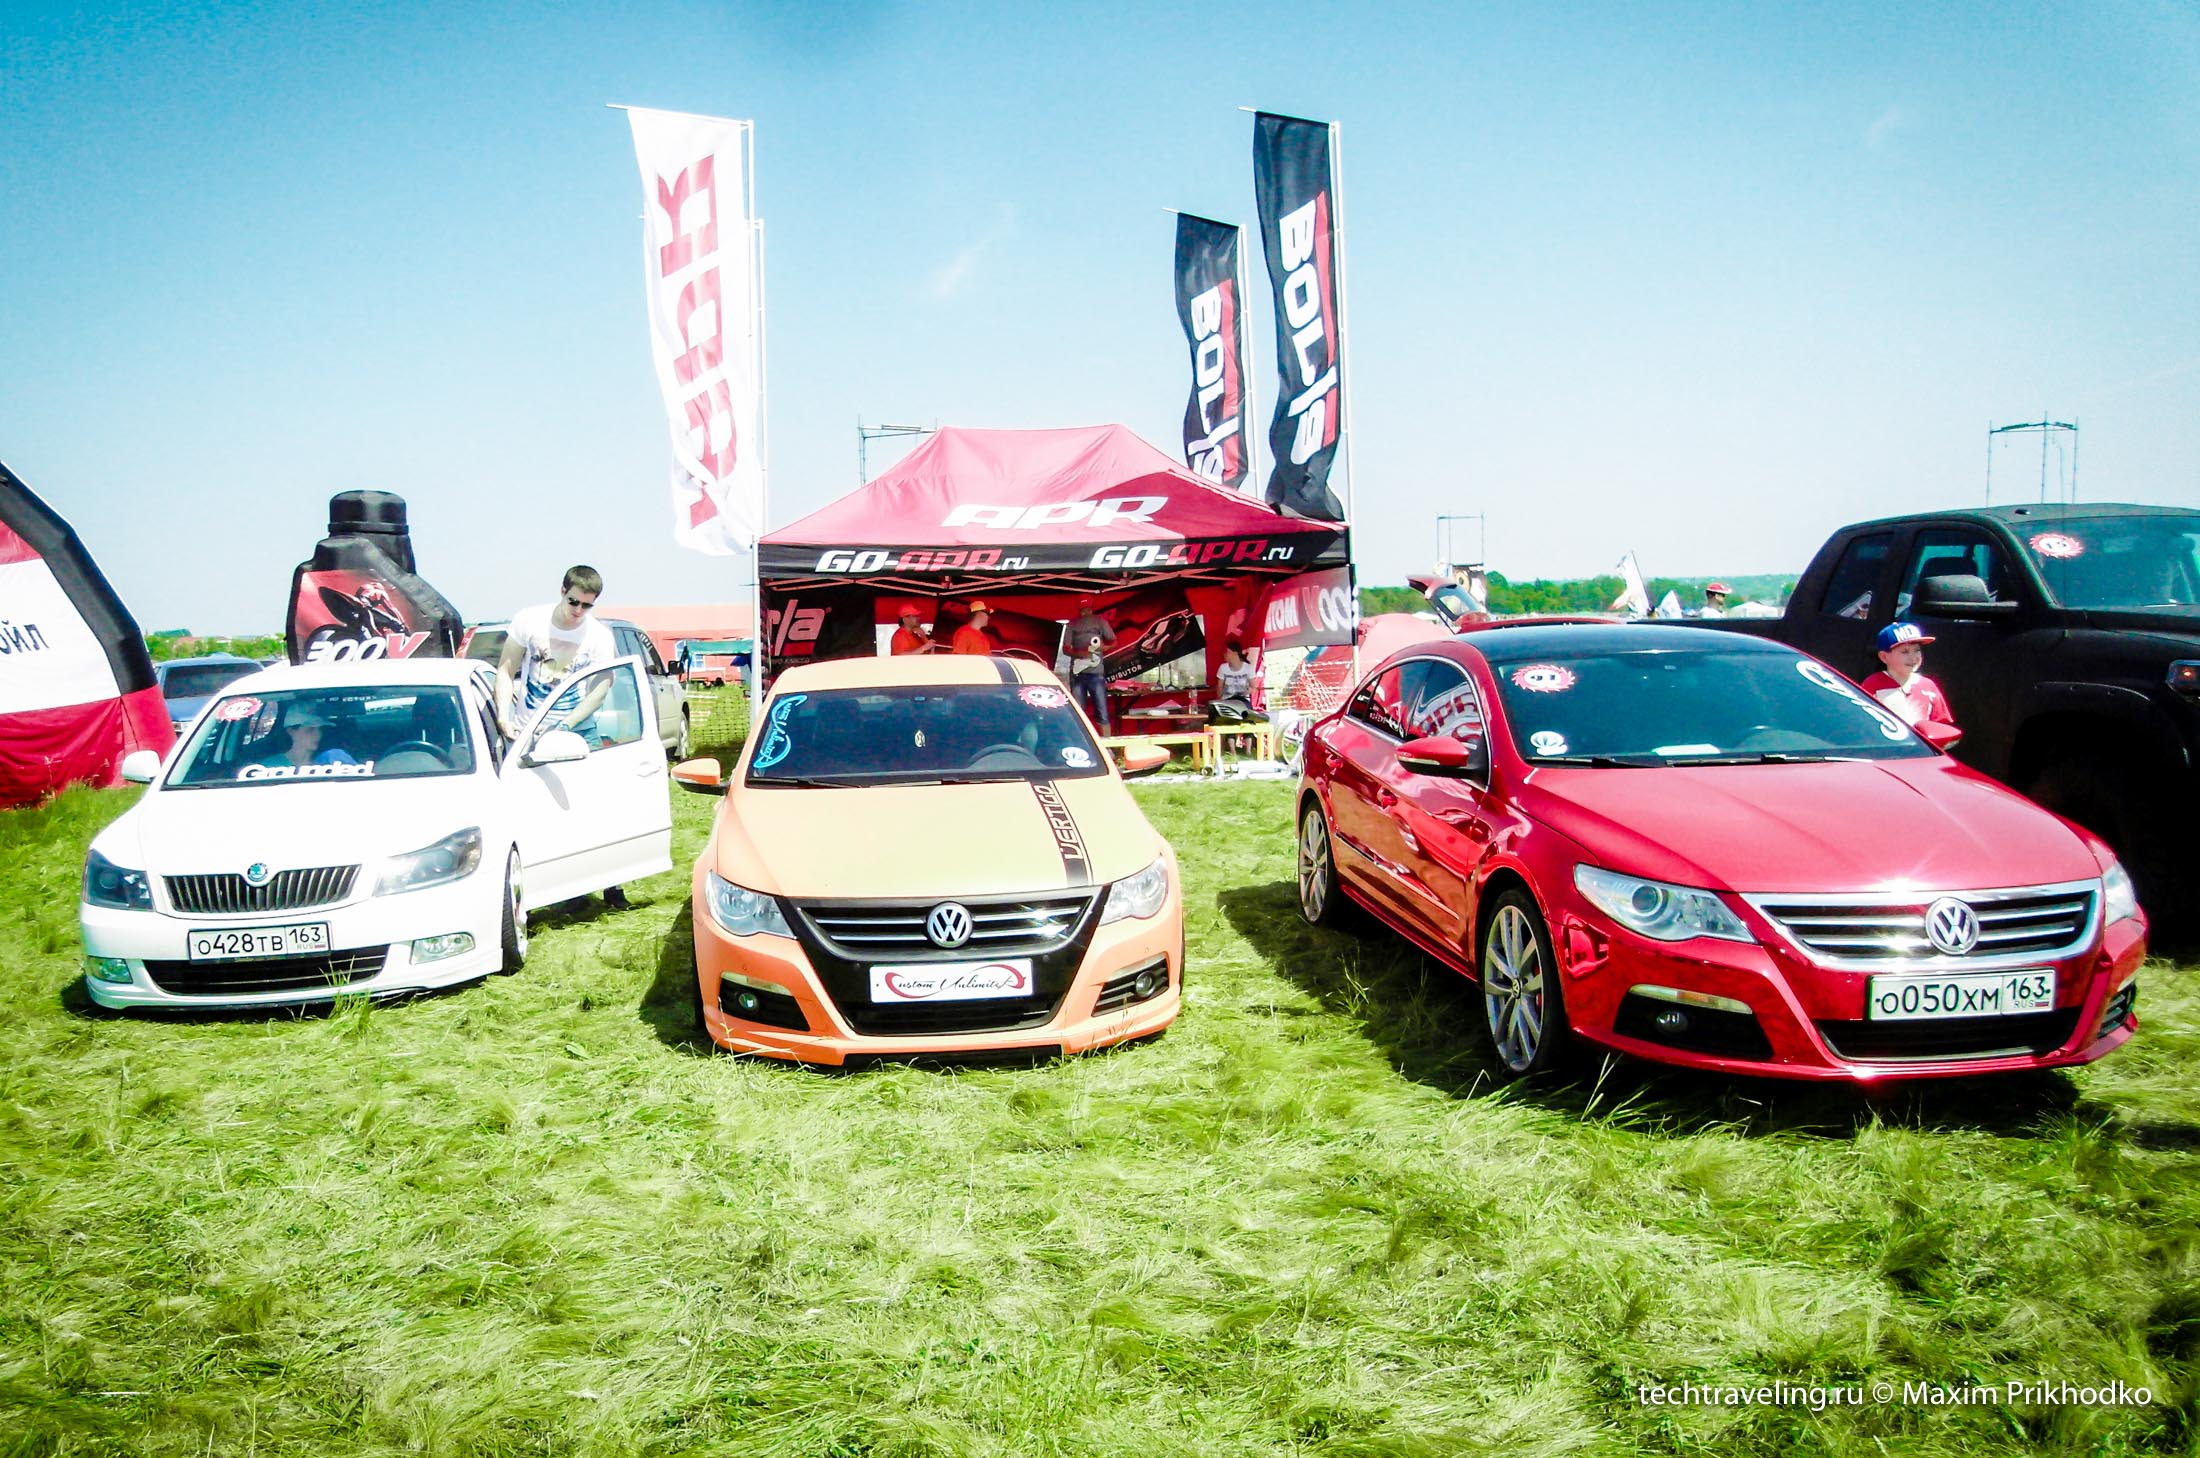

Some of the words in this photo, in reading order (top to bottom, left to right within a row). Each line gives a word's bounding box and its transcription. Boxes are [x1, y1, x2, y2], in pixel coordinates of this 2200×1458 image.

[940, 496, 1169, 529] APR
[815, 549, 1029, 573] GO-APR.ru
[1088, 539, 1294, 569] GO-APR.ru
[306, 631, 431, 663] 300V
[237, 761, 375, 782] Grounded
[289, 927, 321, 944] 163
[2006, 976, 2046, 1000] 163
[2013, 999, 2034, 1009] RUS
